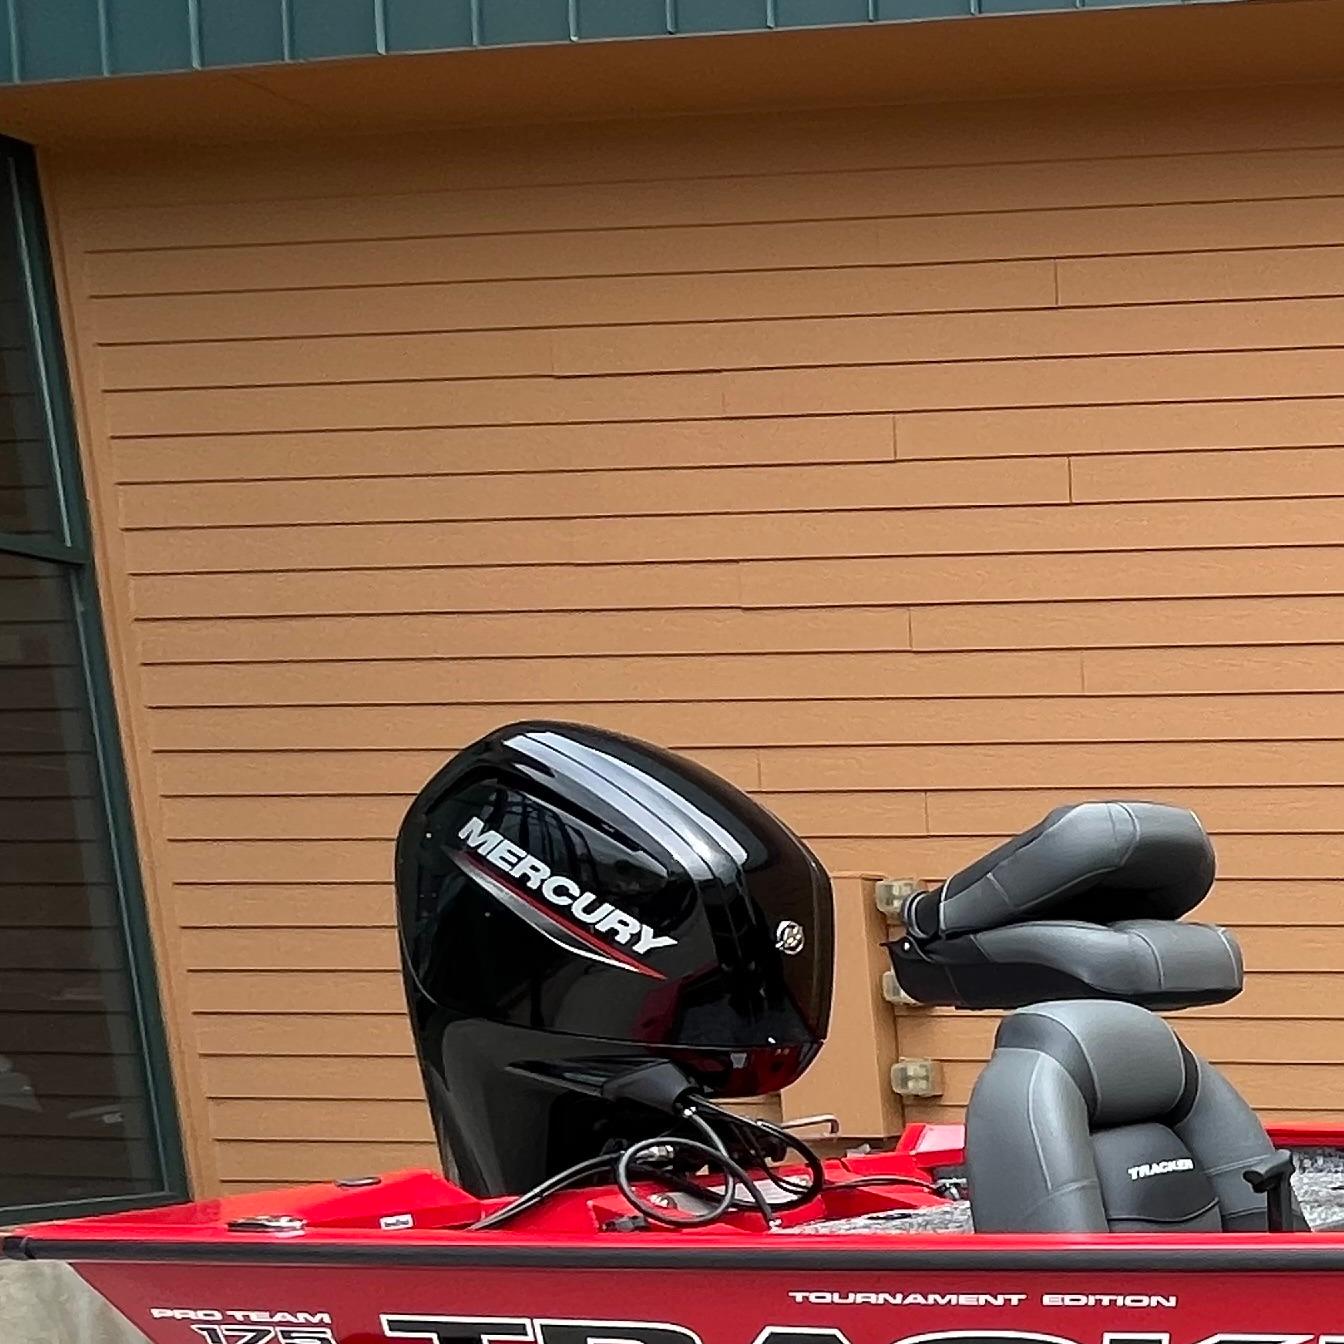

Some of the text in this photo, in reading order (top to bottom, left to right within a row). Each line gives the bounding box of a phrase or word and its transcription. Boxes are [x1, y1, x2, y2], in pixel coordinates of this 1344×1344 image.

[458, 817, 678, 954] MERCURY
[1127, 1158, 1194, 1180] TRACKER
[788, 1291, 1177, 1307] TOURNAMENT EDITION
[151, 1308, 332, 1324] PRO TEAM
